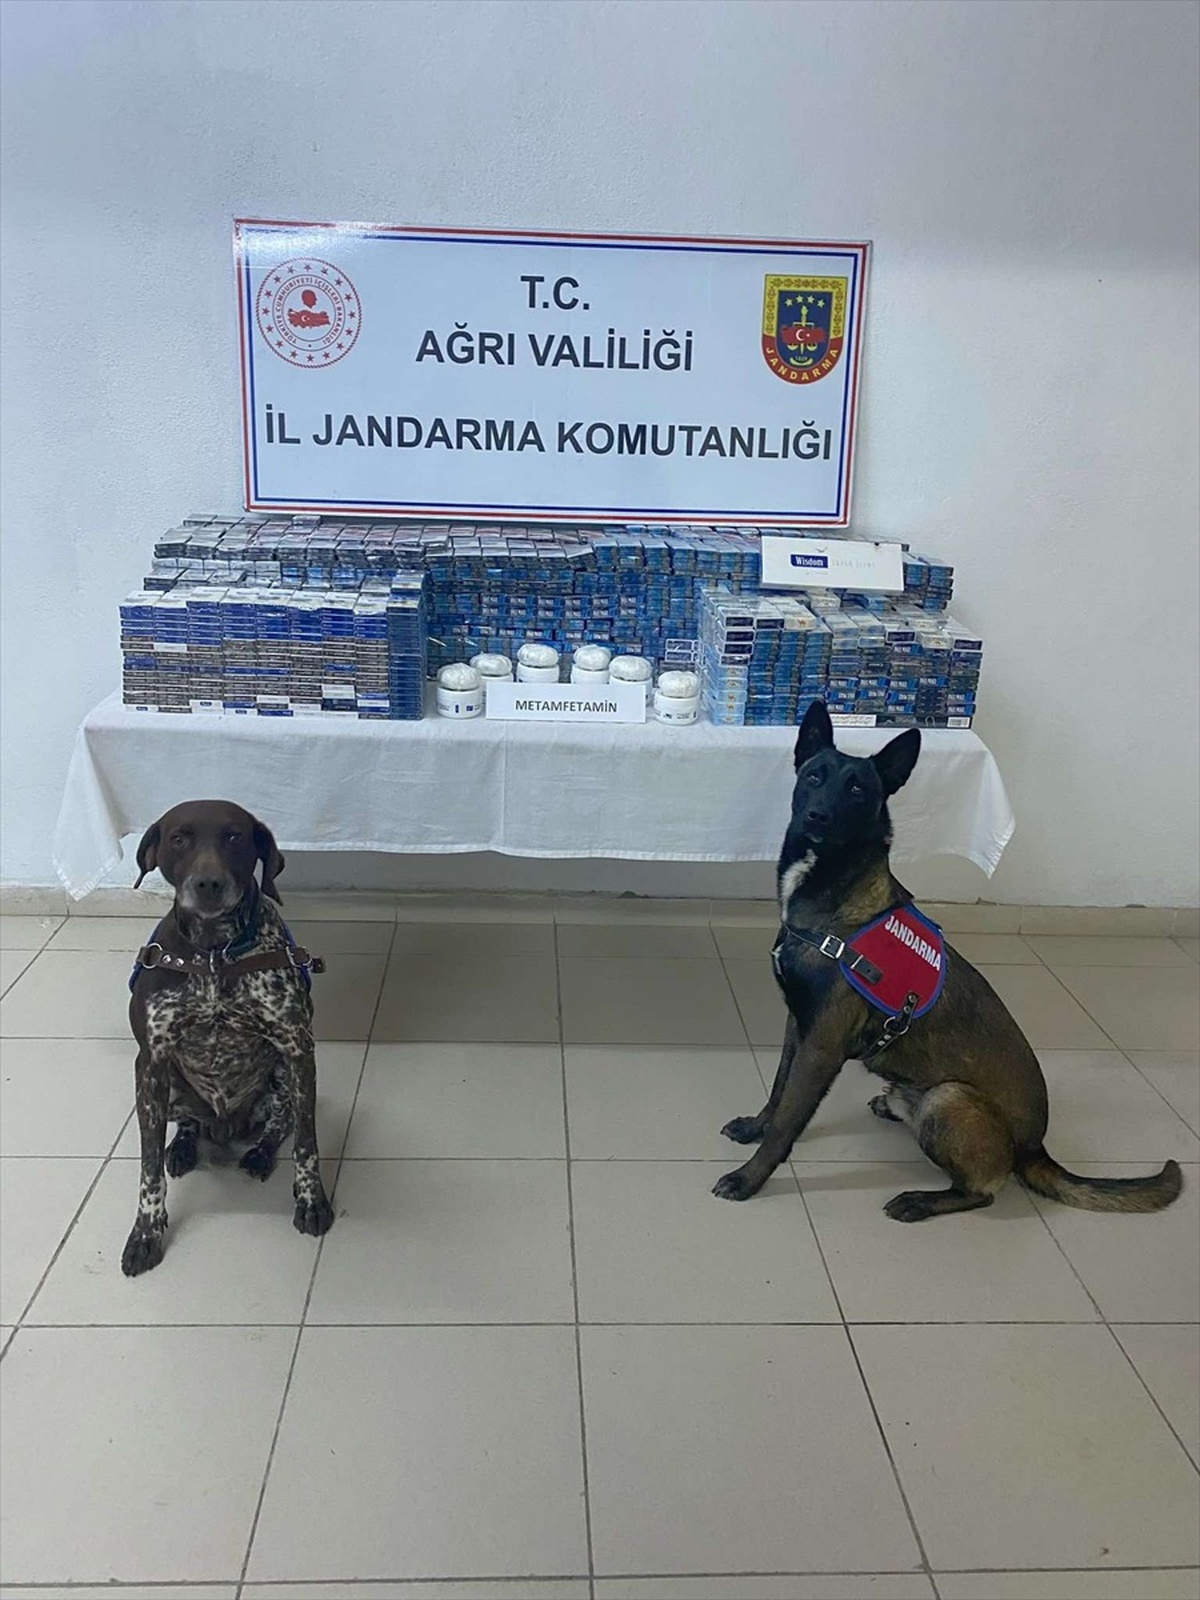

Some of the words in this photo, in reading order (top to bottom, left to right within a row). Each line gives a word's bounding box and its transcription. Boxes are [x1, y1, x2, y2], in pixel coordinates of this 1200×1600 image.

[521, 276, 589, 310] T.C.
[416, 322, 514, 365] AĞRI
[528, 328, 692, 370] VALİLİĞİ
[766, 347, 839, 381] JANDARMA
[266, 404, 300, 444] İL
[313, 415, 545, 452] JANDARMA
[558, 421, 831, 459] KOMUTANLIĞI
[795, 555, 824, 567] Wisdom
[516, 701, 616, 712] METAMFETAMİN
[884, 915, 942, 971] JANDARMA
